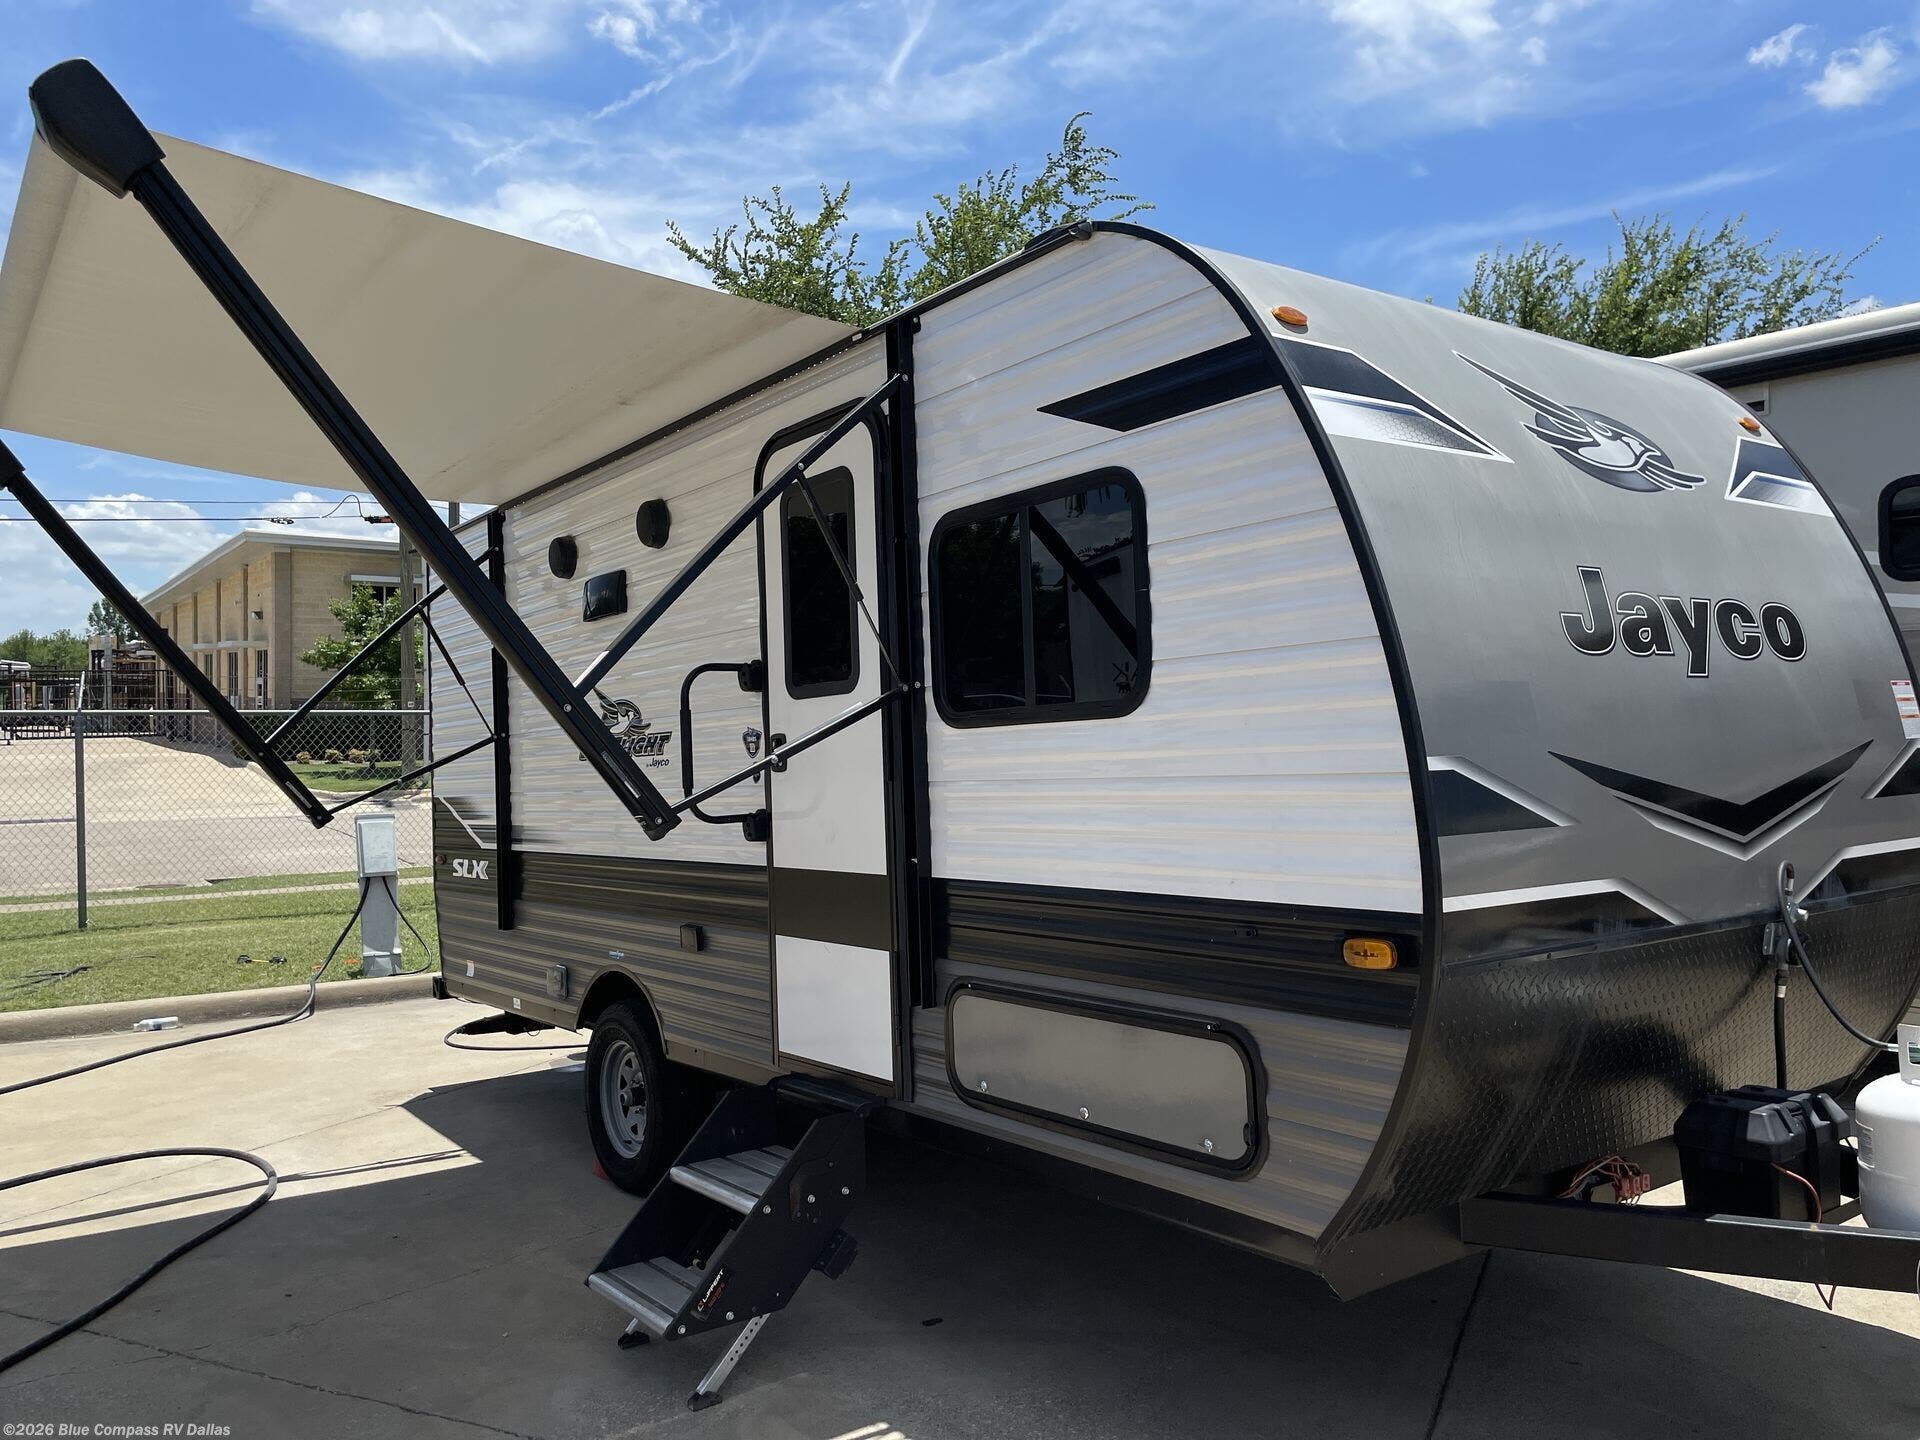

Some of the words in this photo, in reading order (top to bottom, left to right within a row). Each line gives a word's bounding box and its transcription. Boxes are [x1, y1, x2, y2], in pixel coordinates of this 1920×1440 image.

[1559, 565, 1808, 678] Jayco
[650, 757, 670, 769] Jayco
[452, 858, 489, 880] SLX
